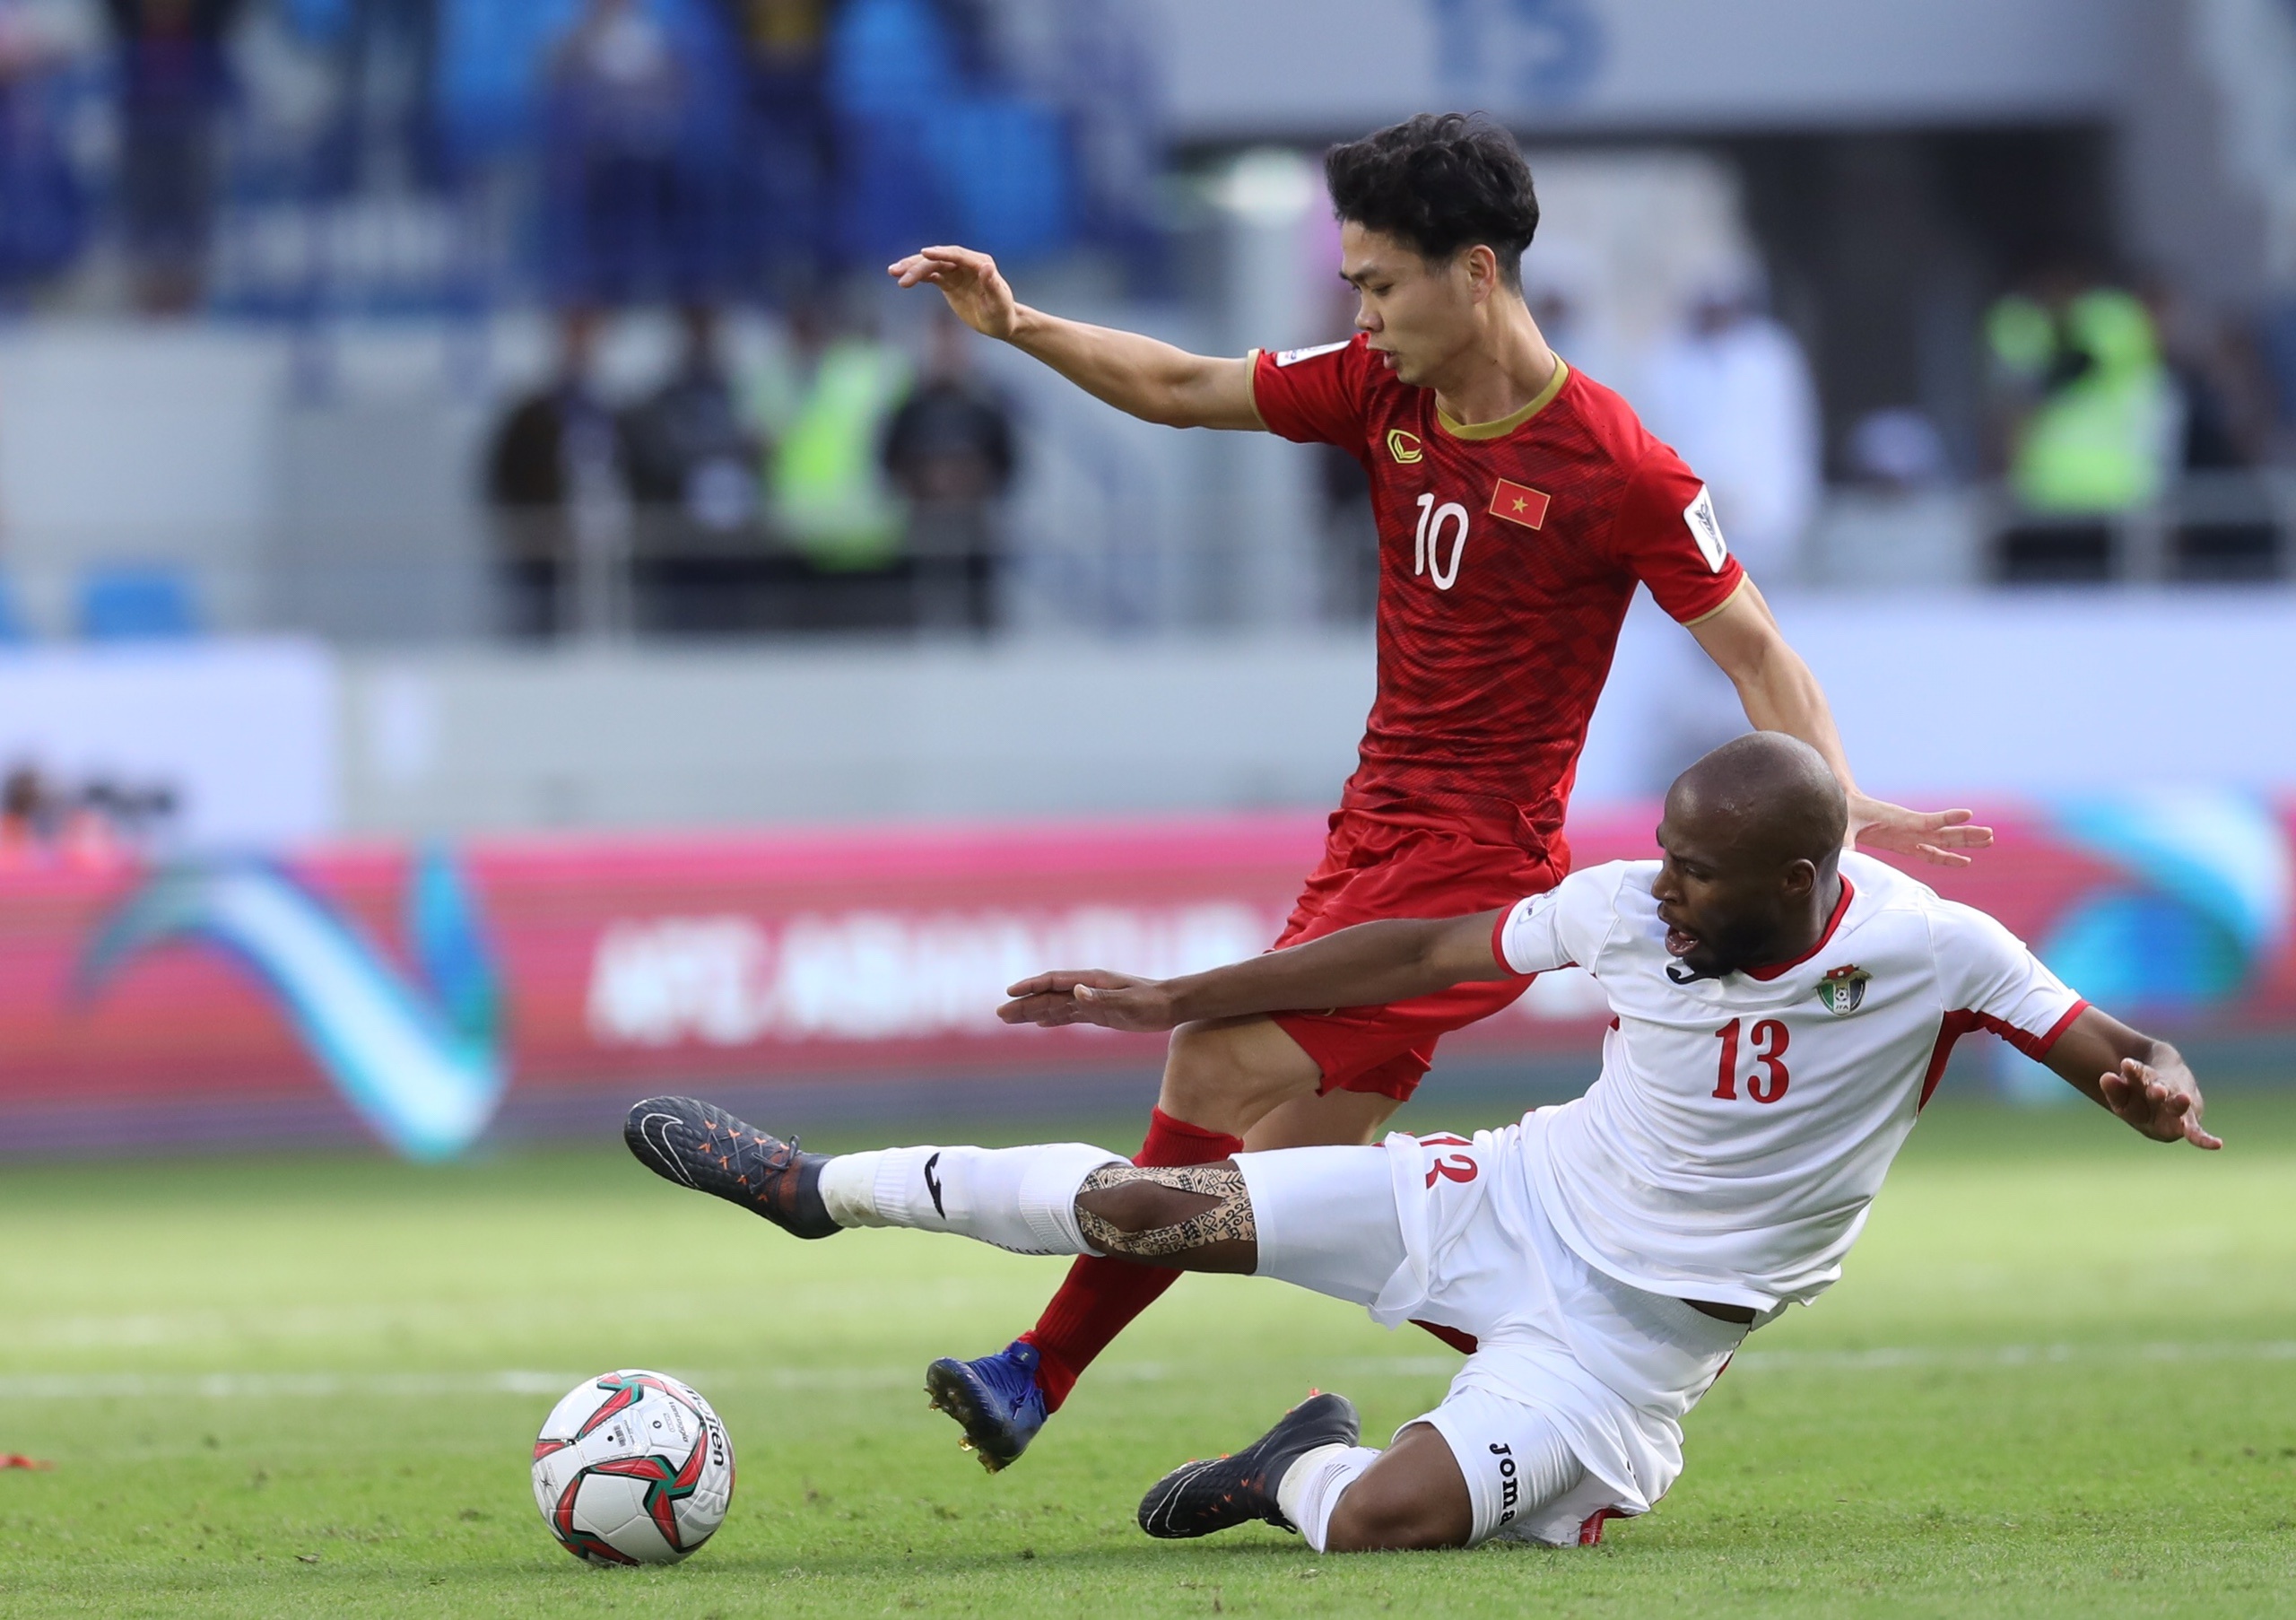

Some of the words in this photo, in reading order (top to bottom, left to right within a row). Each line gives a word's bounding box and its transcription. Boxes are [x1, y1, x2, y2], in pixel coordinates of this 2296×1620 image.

[1414, 492, 1469, 590] 10
[1712, 1018, 1790, 1103] 13
[680, 1384, 725, 1467] molten
[1489, 1443, 1518, 1527] Joma
